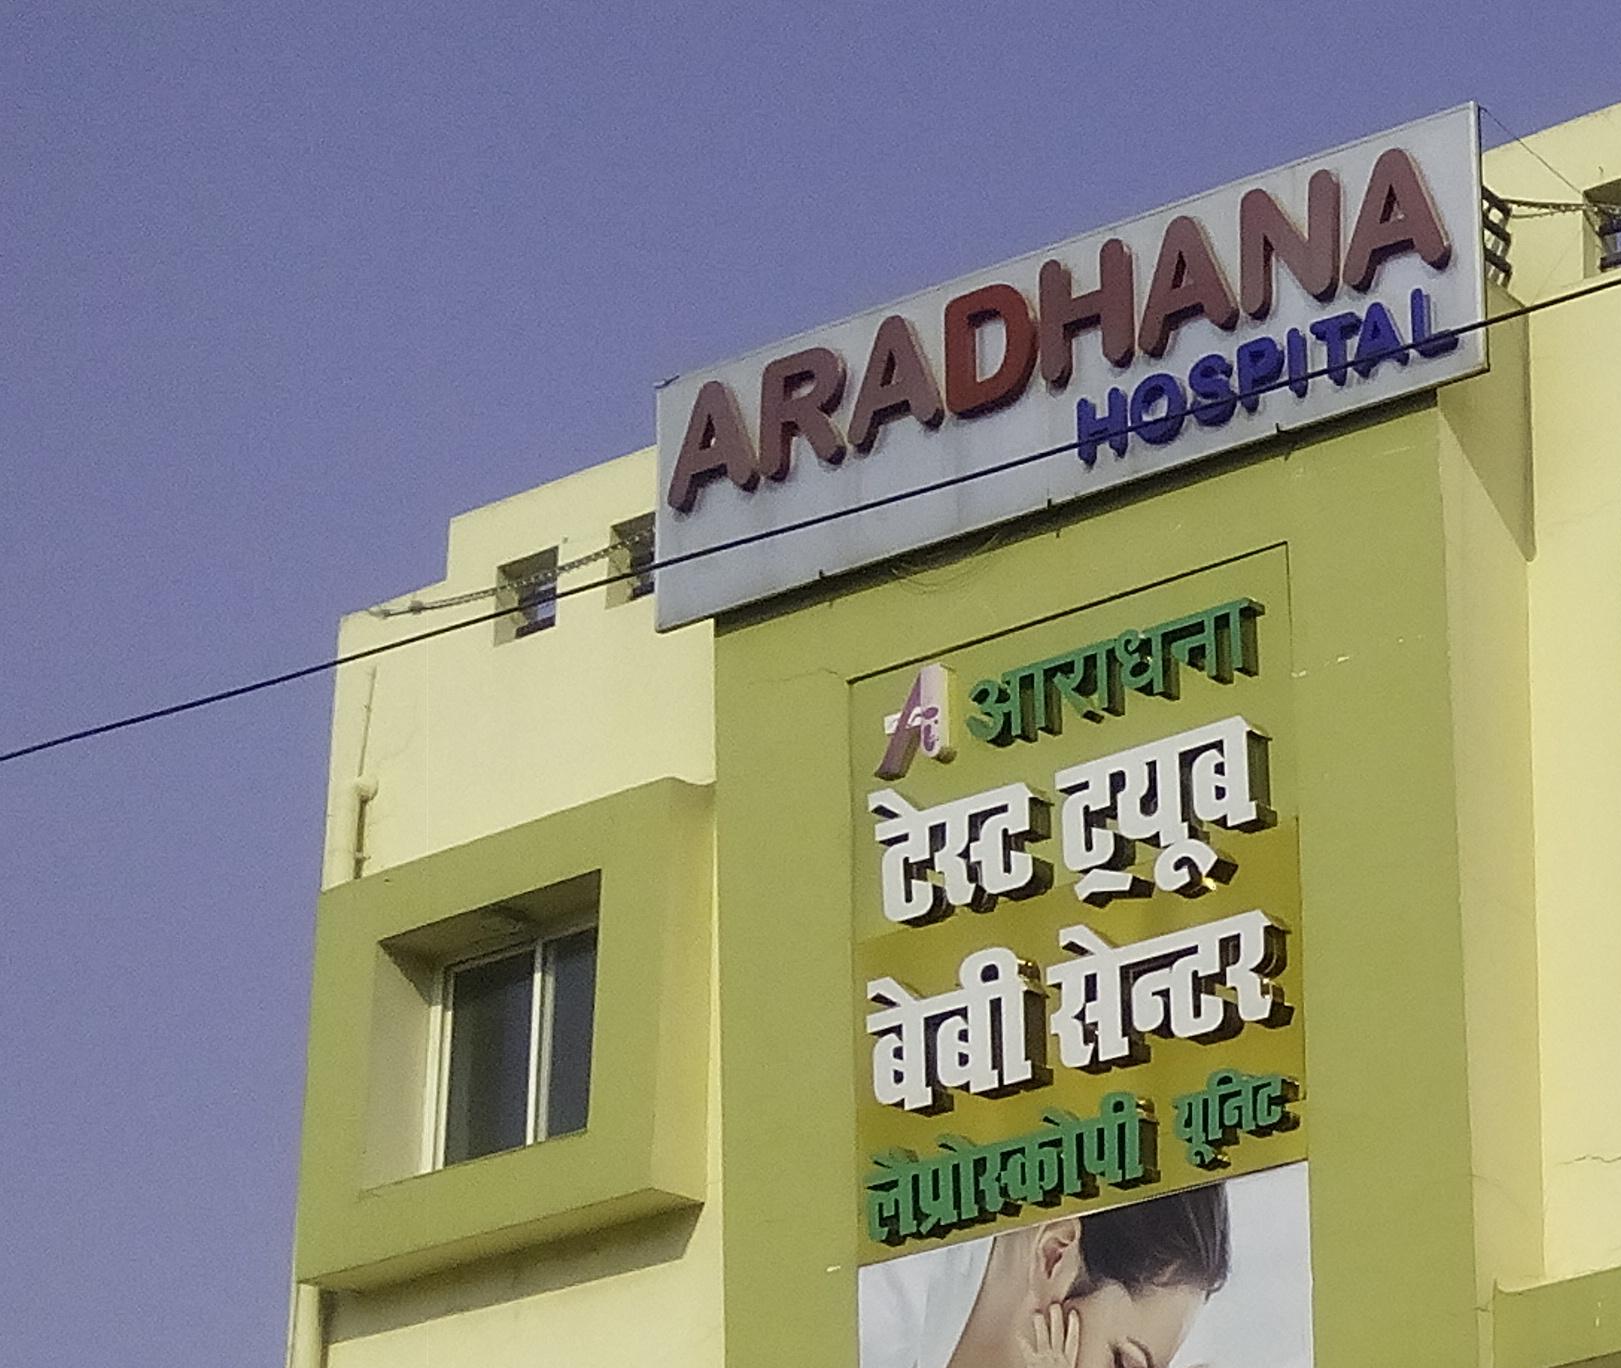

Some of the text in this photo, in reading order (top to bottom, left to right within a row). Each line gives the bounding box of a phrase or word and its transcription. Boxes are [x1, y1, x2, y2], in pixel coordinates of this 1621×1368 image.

[667, 147, 1453, 513] ARADHANA
[1077, 288, 1459, 467] HOSPITAL
[966, 598, 1262, 745] आराधना
[867, 716, 1272, 926] टेस्ट ट्यूब
[867, 911, 1290, 1115] बेबी सेन्टर
[1173, 1070, 1297, 1167] यूनिट
